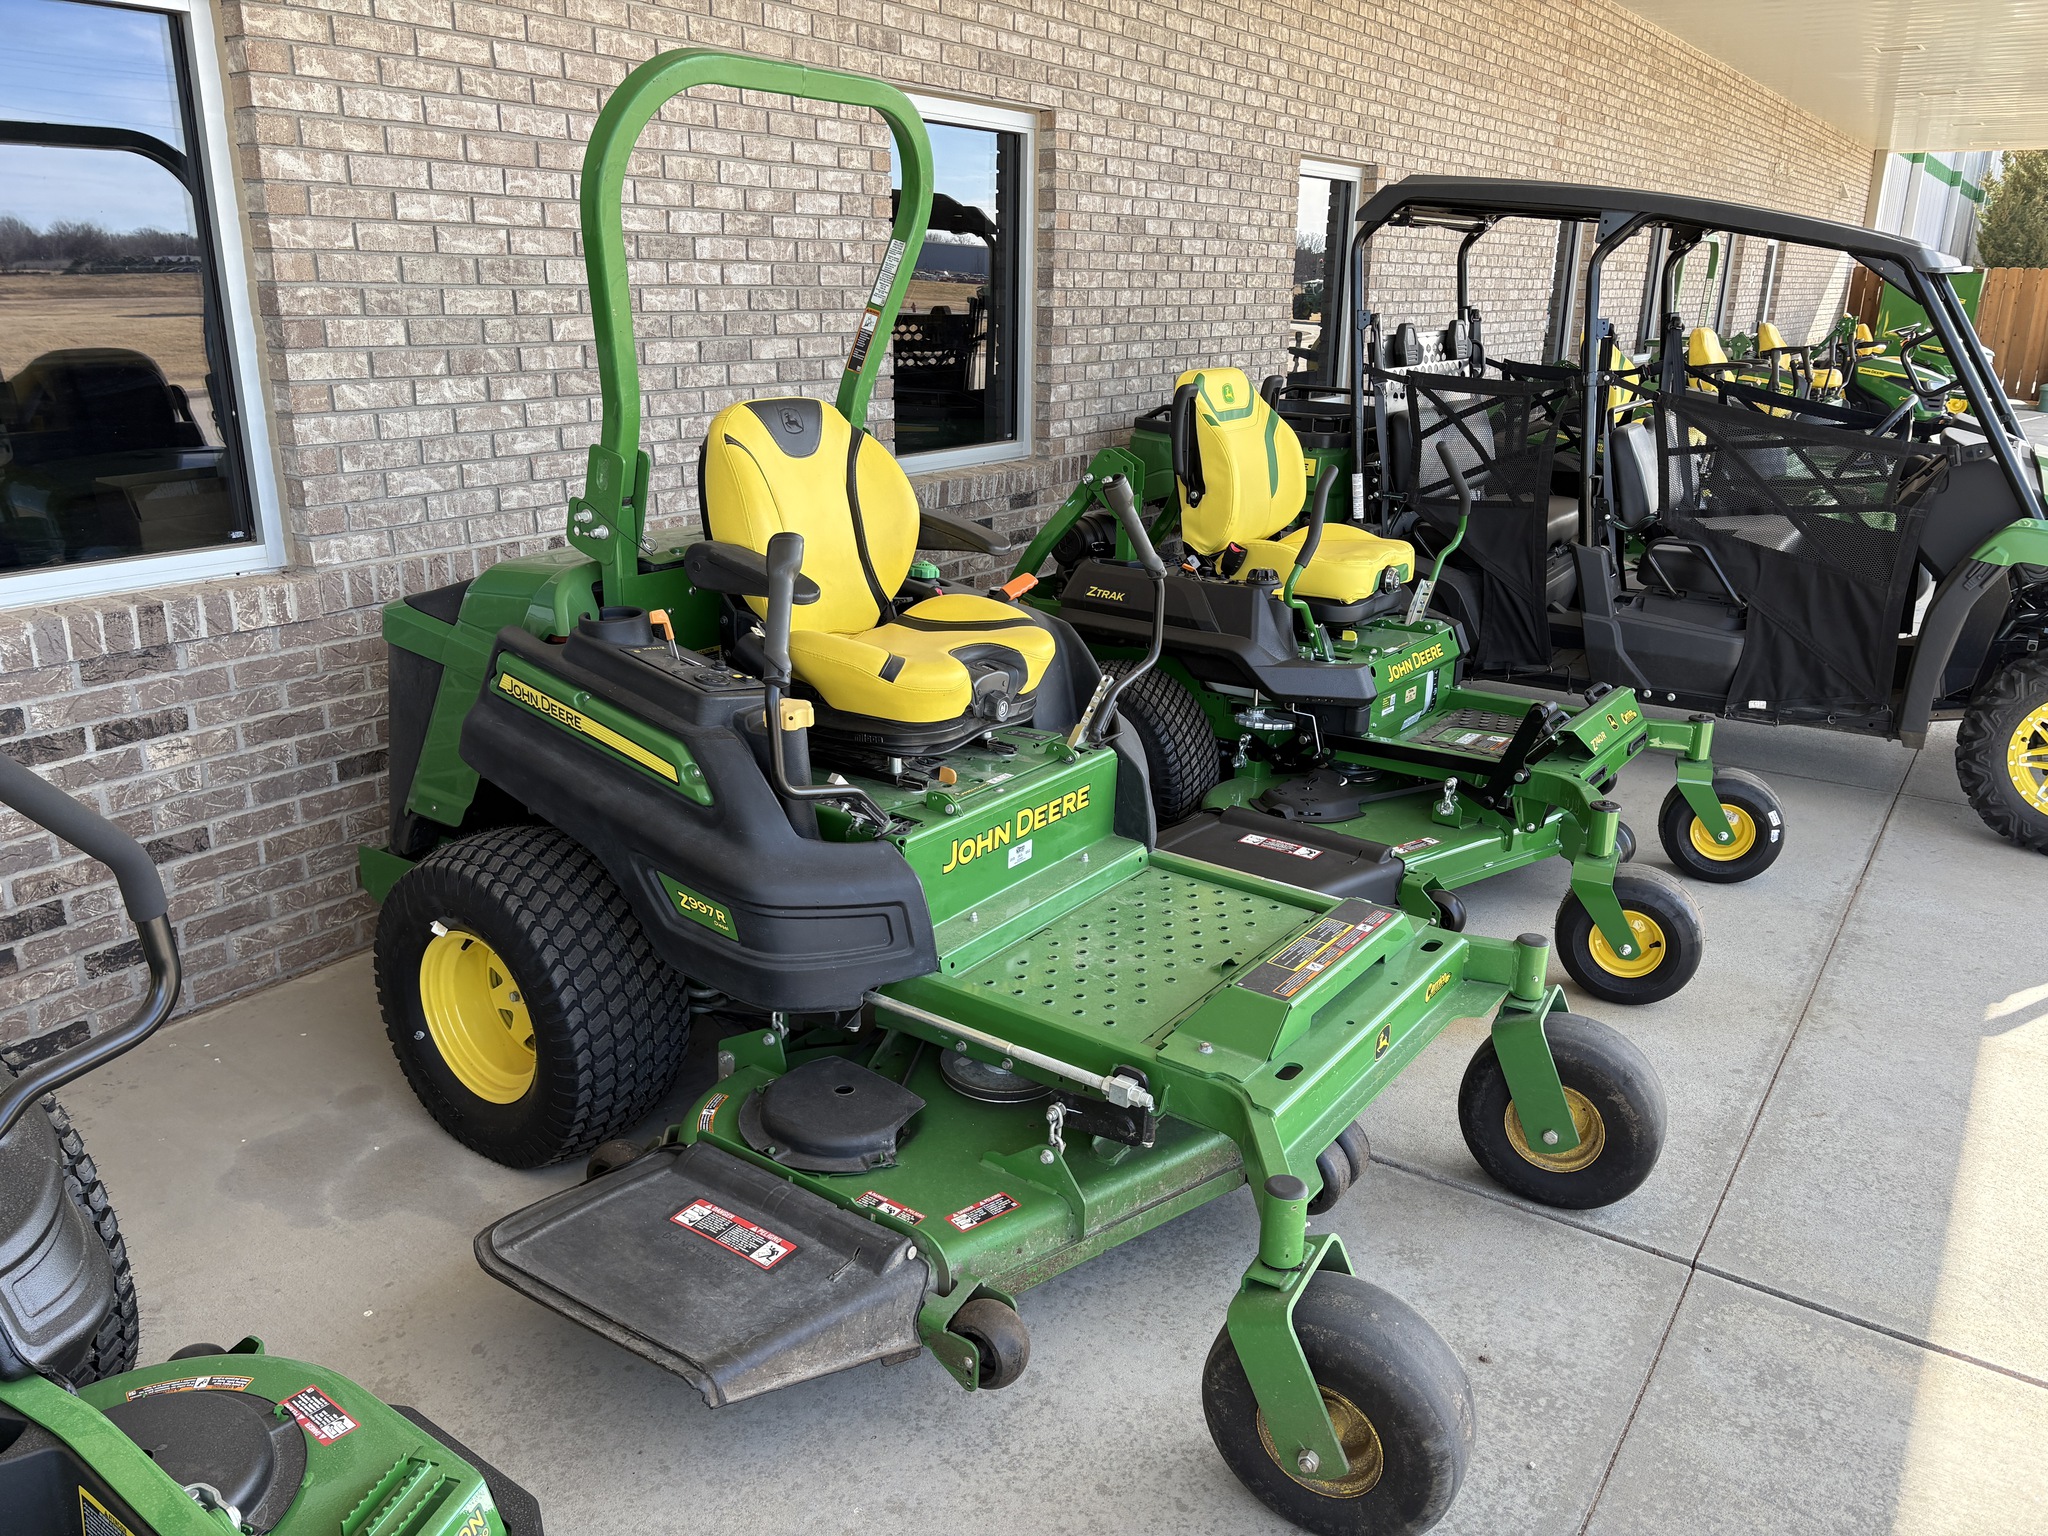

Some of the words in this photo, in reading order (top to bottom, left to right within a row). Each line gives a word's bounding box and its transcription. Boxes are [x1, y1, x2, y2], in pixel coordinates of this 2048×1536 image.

[1086, 585, 1126, 602] ZTRAK
[1388, 658, 1414, 683] JOHN
[1411, 642, 1444, 669] DEERE
[507, 679, 539, 708] JOHN
[541, 695, 582, 730] DEERE
[942, 819, 1012, 875] JOHN
[1016, 783, 1091, 840] DEERE
[710, 1205, 737, 1221] DANGER
[756, 1227, 783, 1244] PELIGRO
[304, 1421, 322, 1437] DANGER
